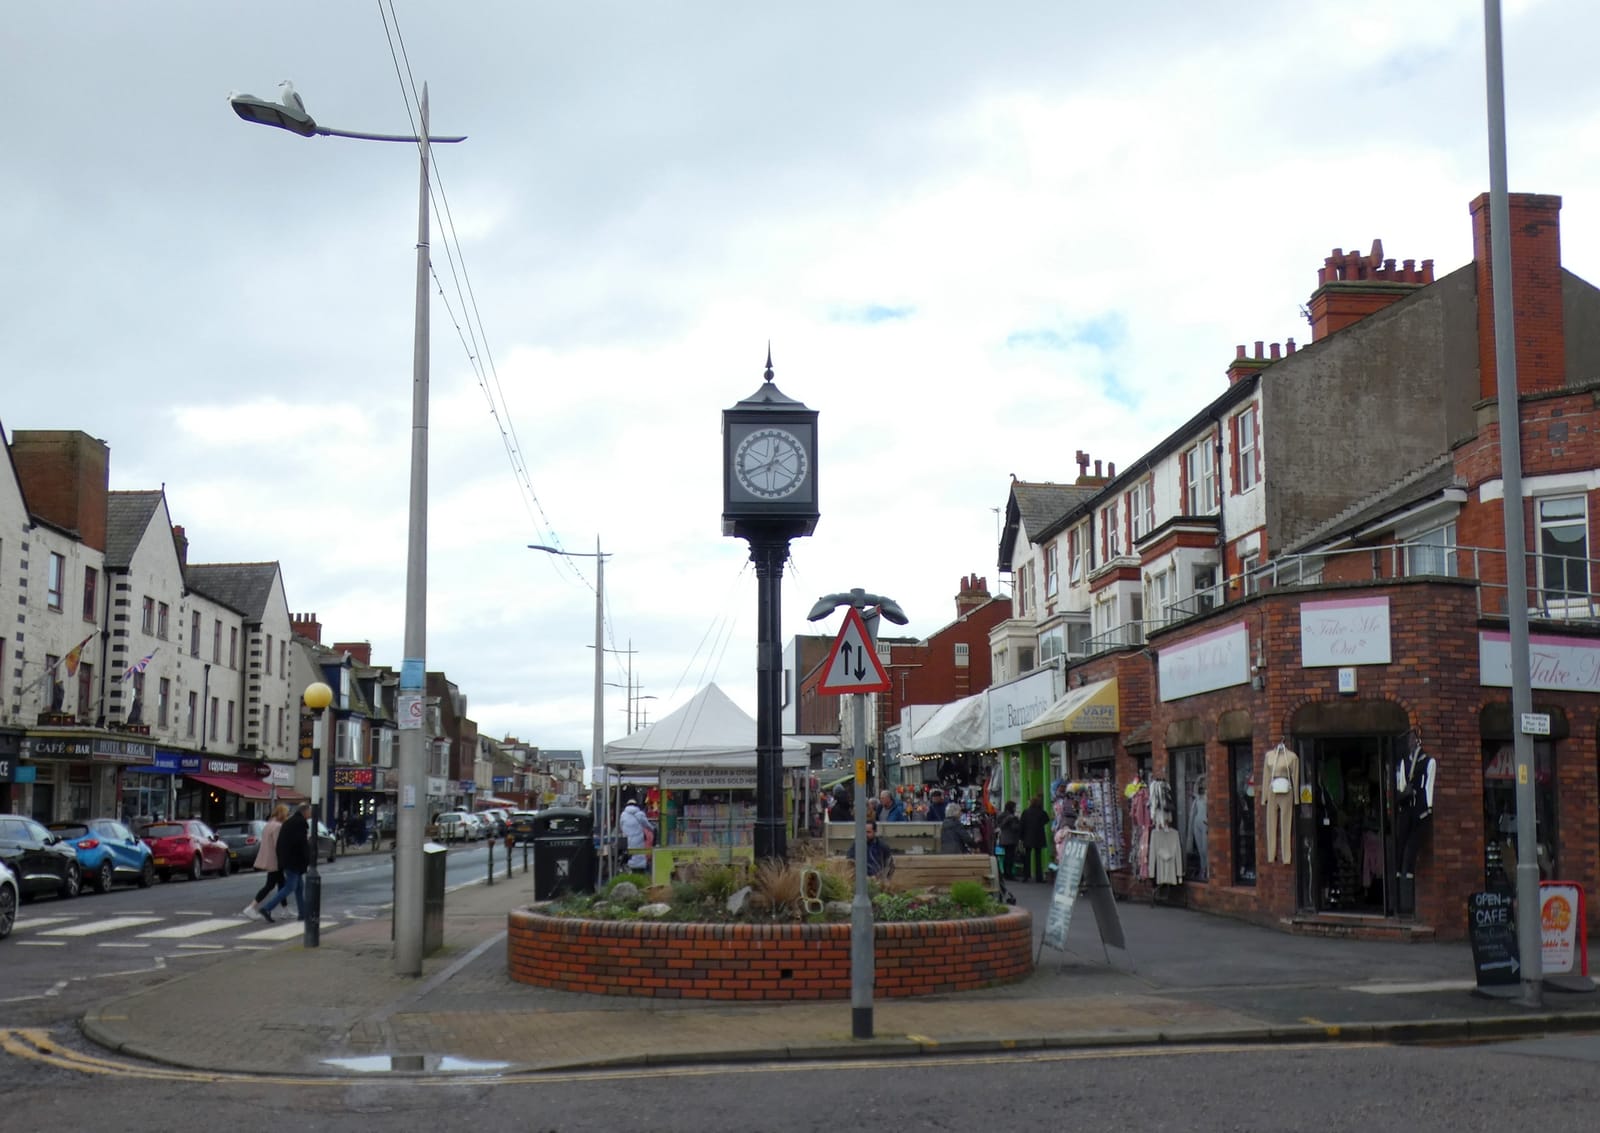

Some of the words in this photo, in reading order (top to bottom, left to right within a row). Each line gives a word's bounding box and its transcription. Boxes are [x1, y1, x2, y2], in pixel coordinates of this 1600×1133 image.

[75, 744, 90, 754] BAR
[1475, 893, 1501, 906] OPEN
[1476, 907, 1508, 924] CAFE
